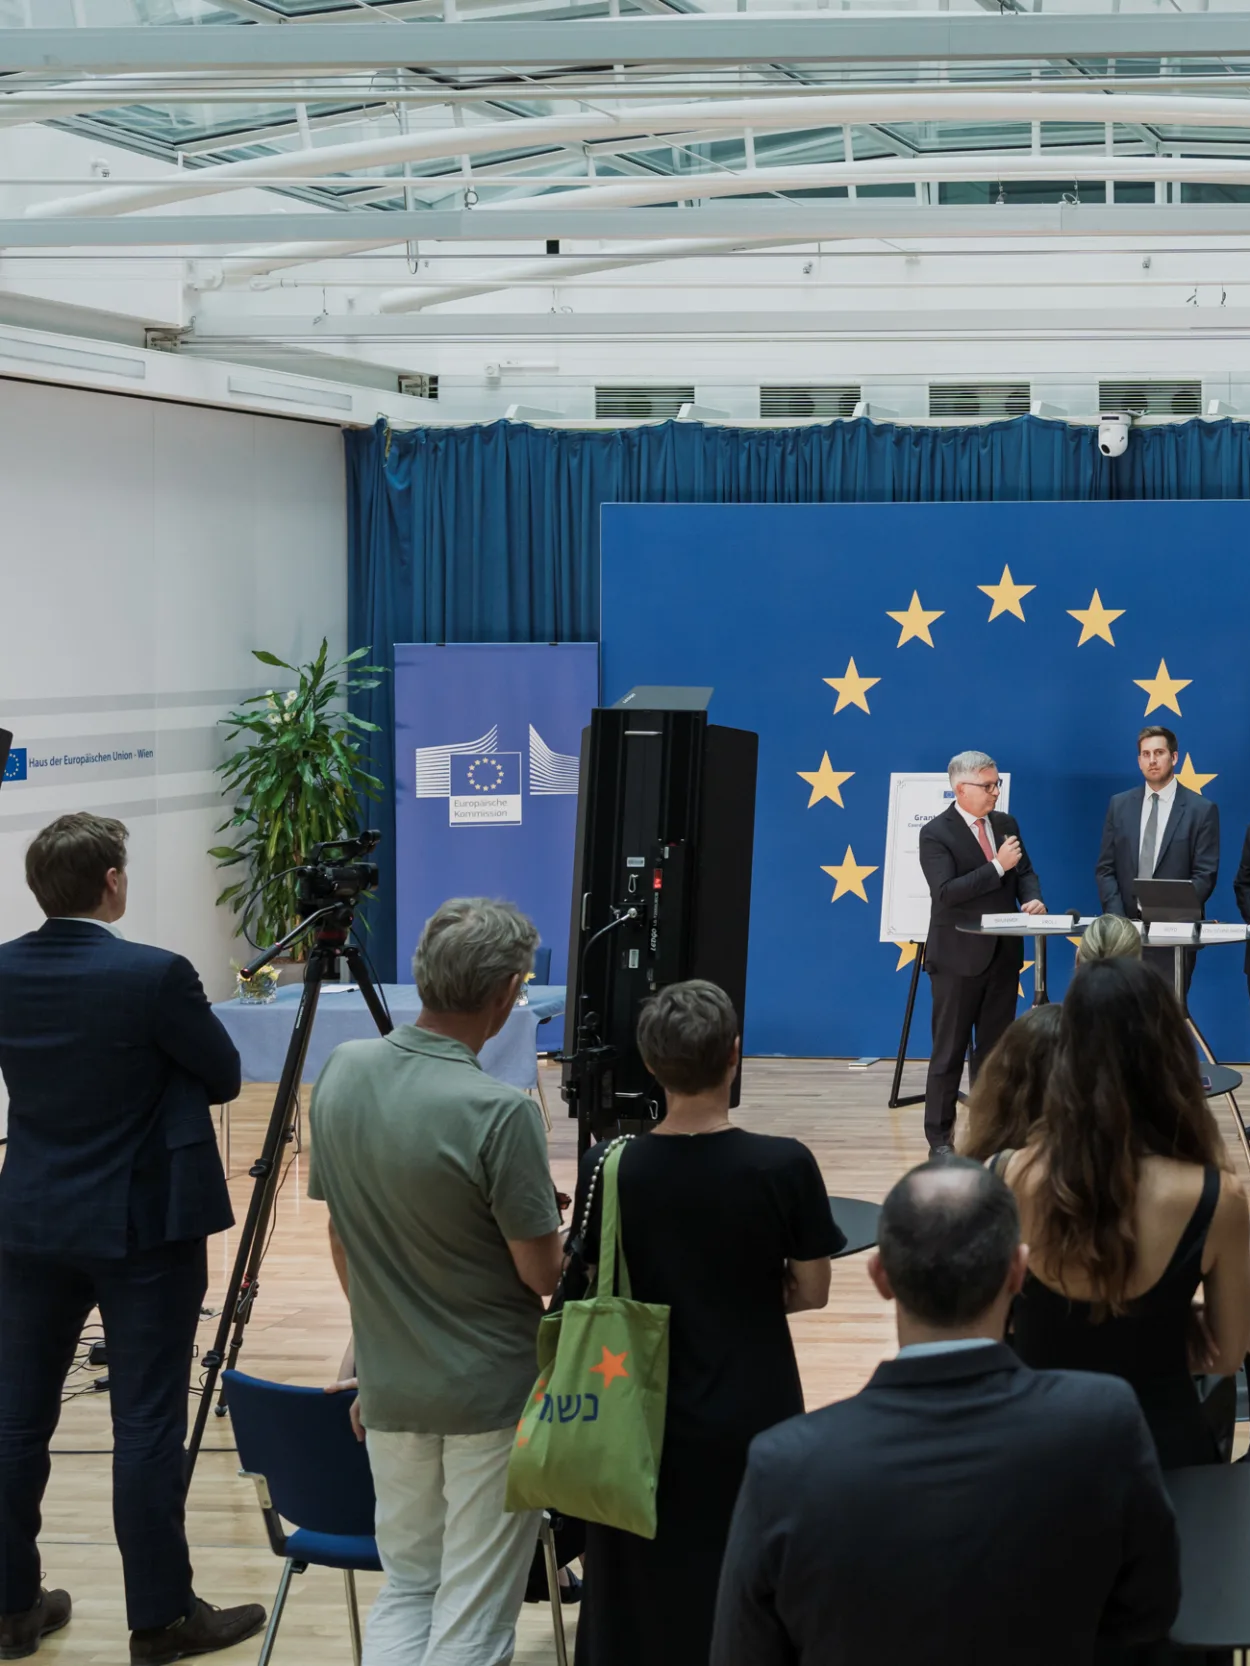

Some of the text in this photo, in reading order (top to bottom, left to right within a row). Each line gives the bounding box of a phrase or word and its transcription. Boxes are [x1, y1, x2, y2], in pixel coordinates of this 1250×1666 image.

[29, 758, 48, 768] Haus
[50, 756, 63, 767] der
[64, 752, 112, 766] Europäischen
[113, 750, 133, 761] Union
[137, 748, 154, 759] Wien
[454, 798, 508, 808] Europäische
[454, 810, 508, 818] Kommission
[650, 928, 658, 951] LEDGO
